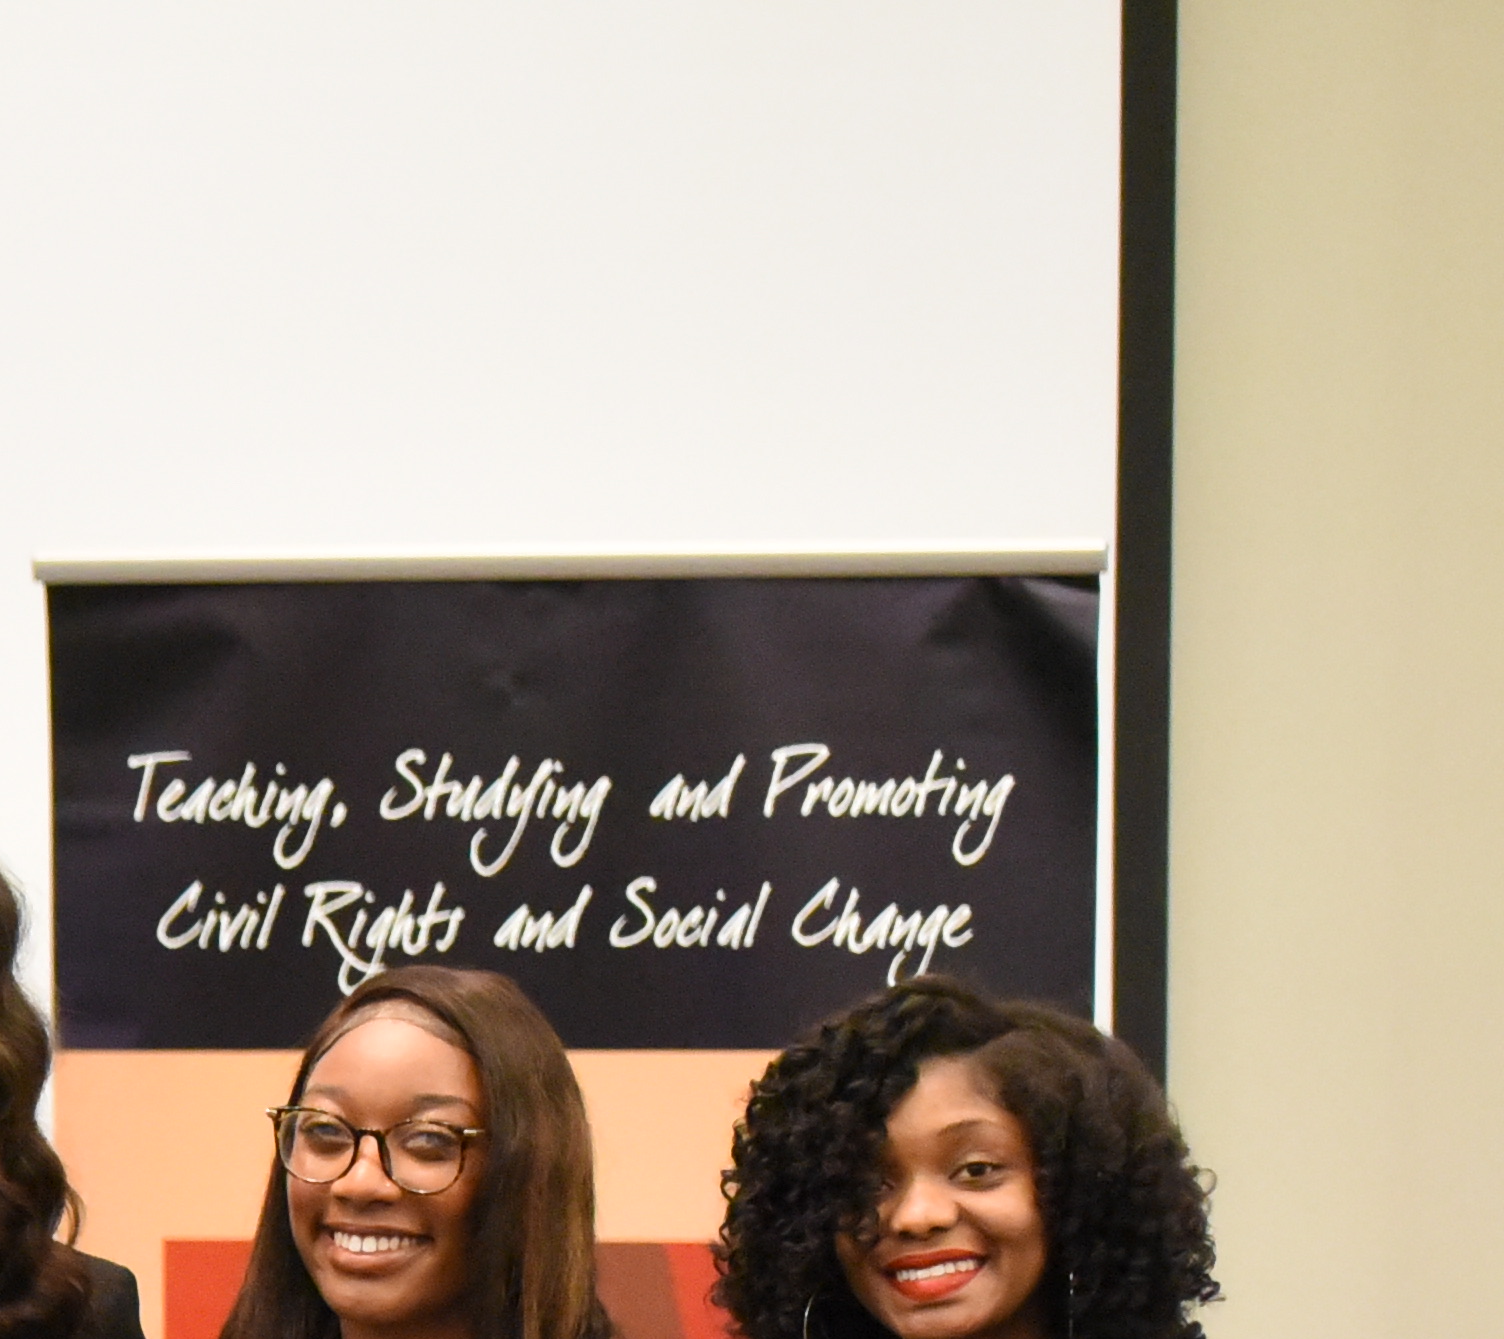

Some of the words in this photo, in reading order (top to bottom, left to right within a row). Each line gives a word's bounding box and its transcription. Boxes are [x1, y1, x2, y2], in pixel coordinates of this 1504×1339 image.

[127, 750, 348, 870] Teaching,
[380, 748, 613, 878] Studying
[648, 752, 747, 822] and
[763, 743, 1016, 866] Promoting
[157, 880, 287, 953] Civil
[302, 881, 467, 996] Rights
[493, 884, 593, 953] and
[609, 876, 773, 950] Social
[791, 876, 973, 987] Change
